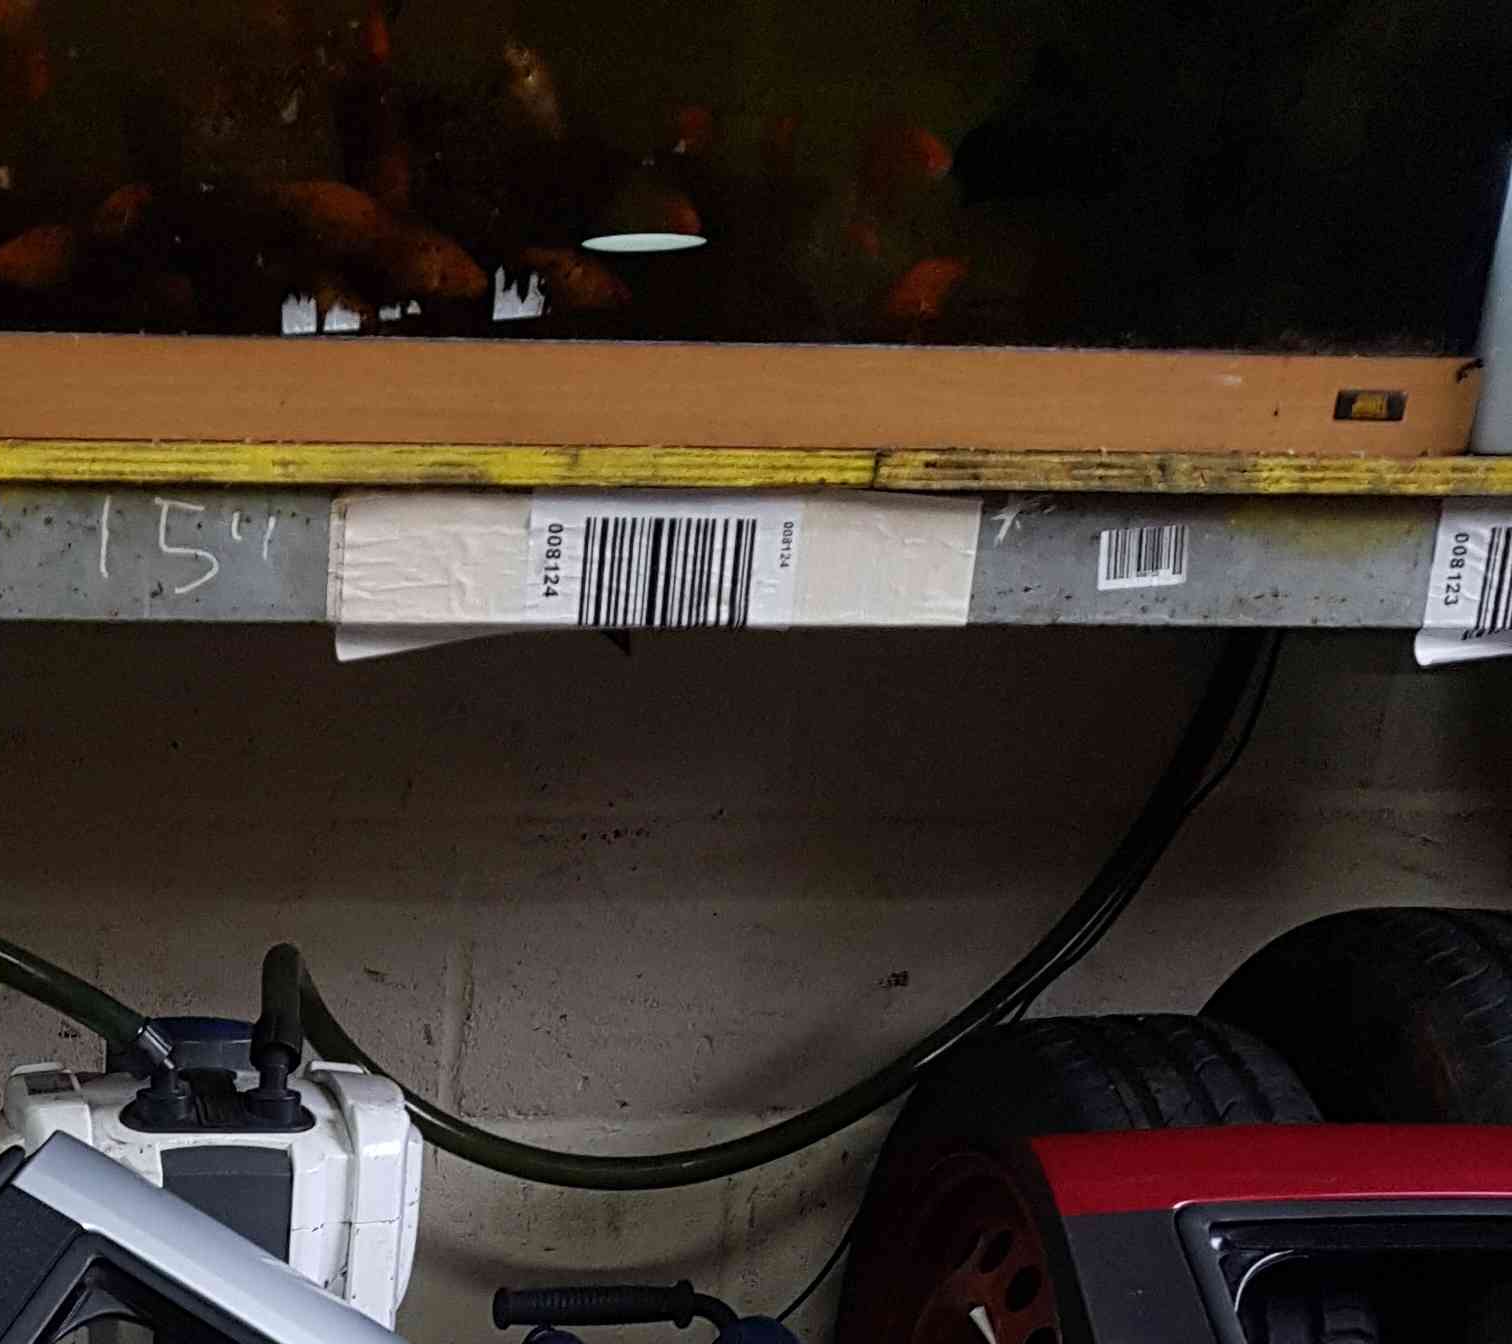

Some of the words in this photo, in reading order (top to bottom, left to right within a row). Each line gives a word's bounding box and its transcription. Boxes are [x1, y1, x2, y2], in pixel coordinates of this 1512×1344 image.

[542, 523, 563, 598] 008124
[780, 521, 794, 568] 008124
[1444, 533, 1469, 606] 008123
